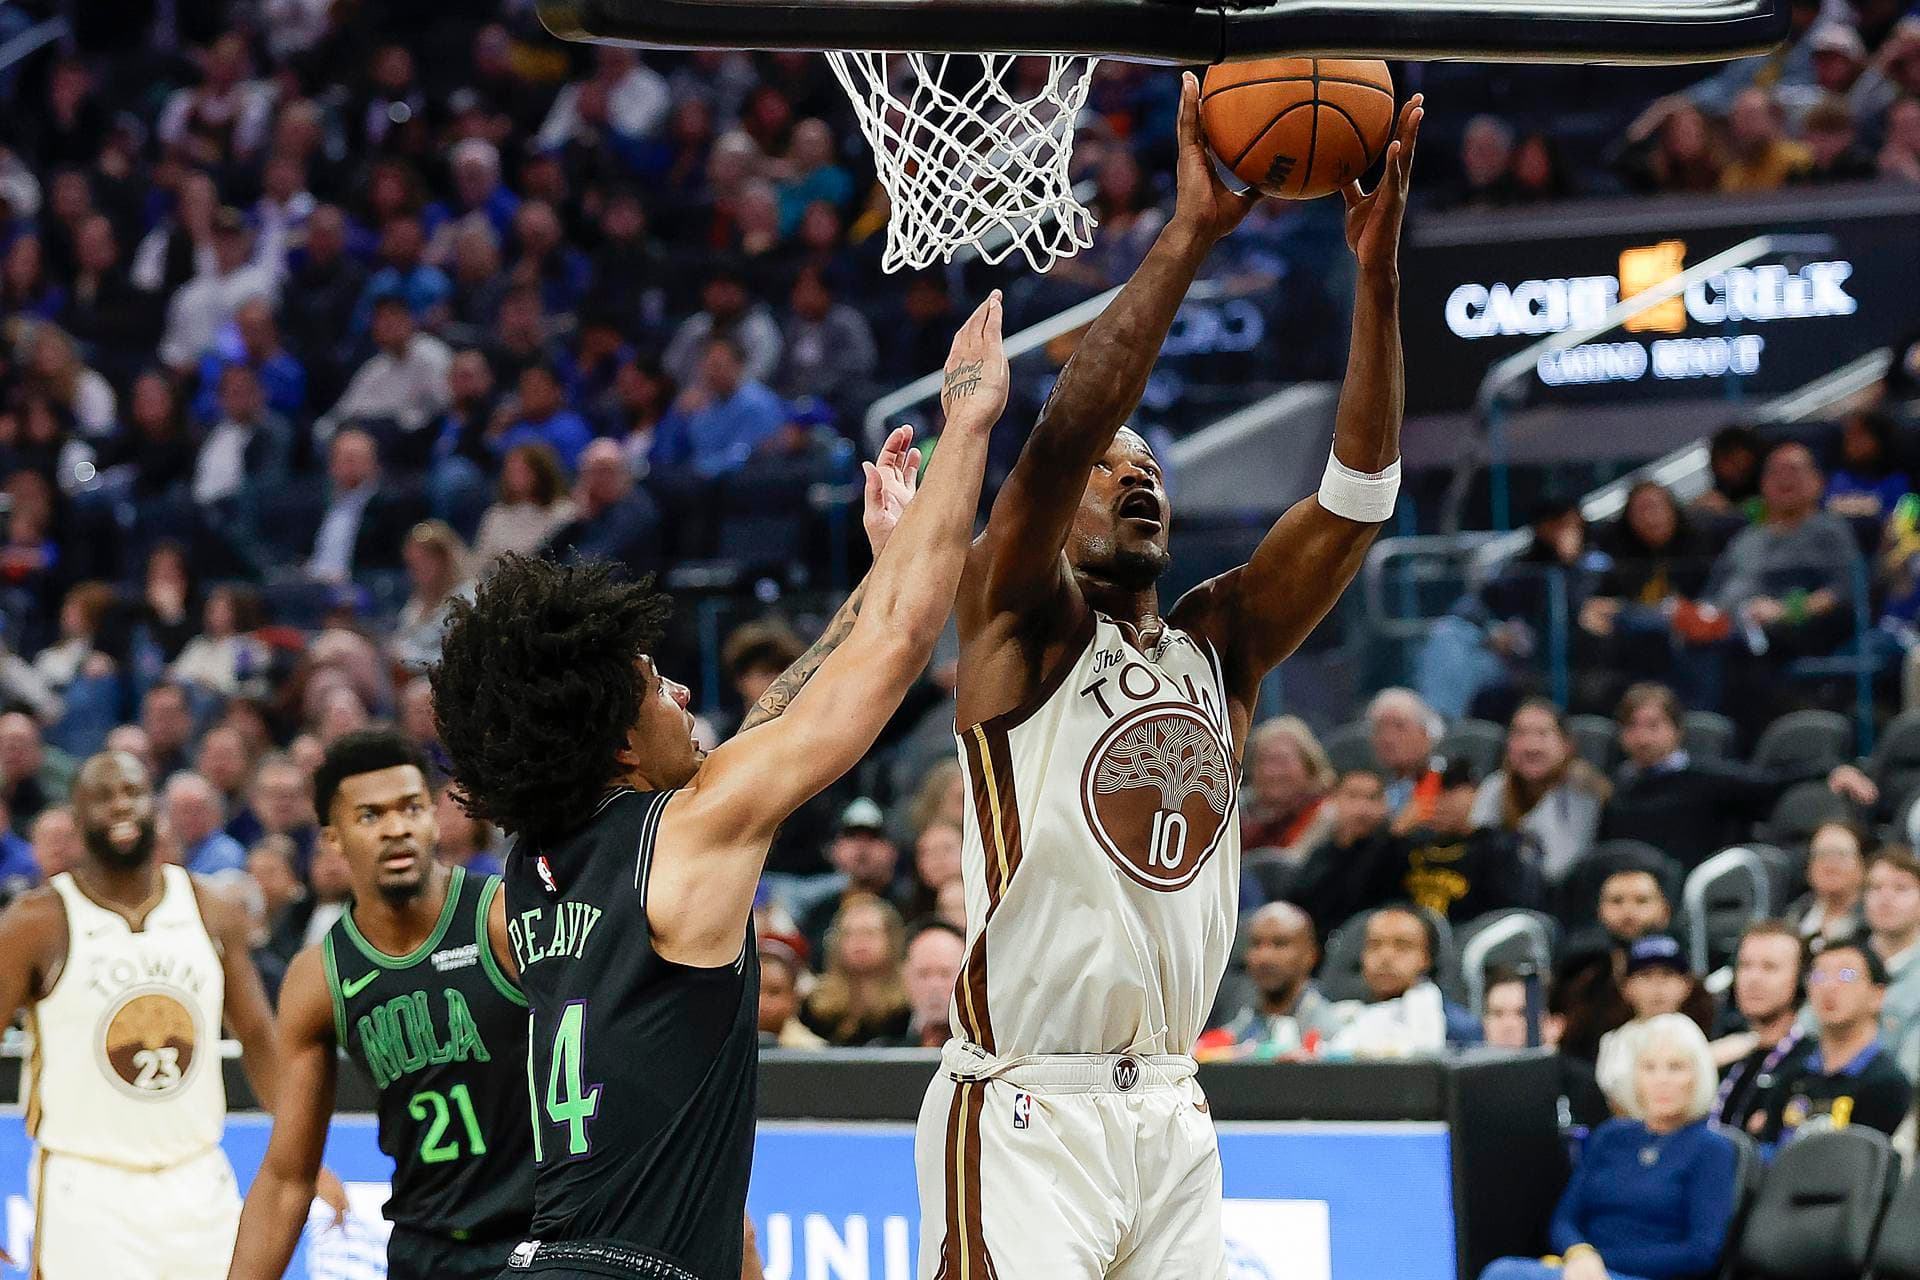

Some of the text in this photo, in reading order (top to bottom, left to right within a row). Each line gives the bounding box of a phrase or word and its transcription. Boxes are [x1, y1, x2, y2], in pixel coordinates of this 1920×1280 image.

[1093, 648, 1125, 674] The
[1148, 809, 1188, 869] 10
[507, 901, 603, 975] PEAVY
[132, 1047, 182, 1090] 23
[358, 988, 492, 1090] NOLA
[408, 1084, 488, 1165] 21
